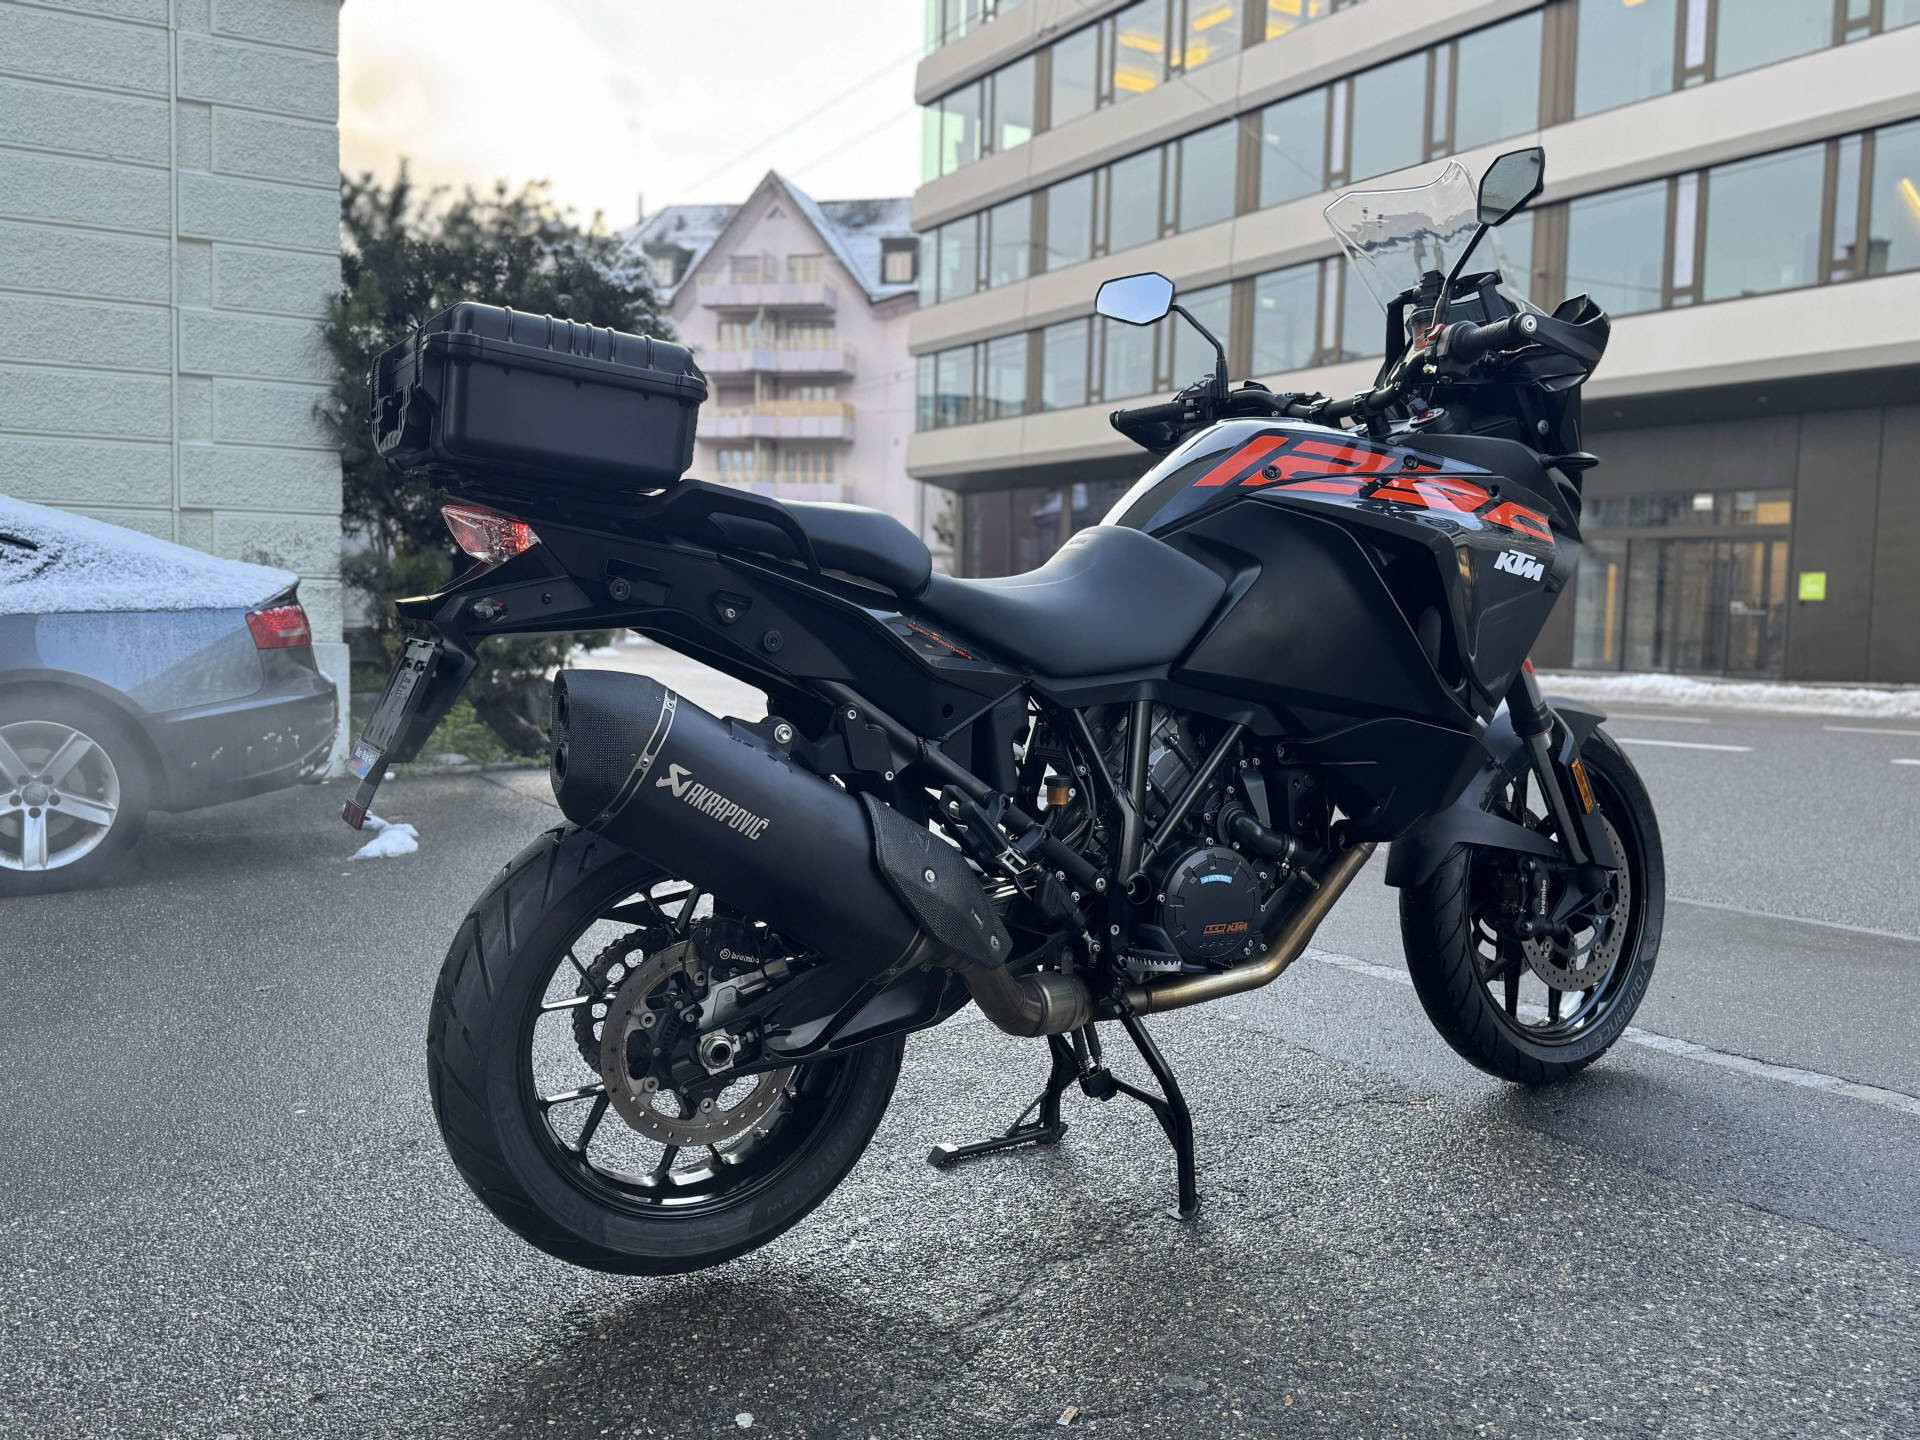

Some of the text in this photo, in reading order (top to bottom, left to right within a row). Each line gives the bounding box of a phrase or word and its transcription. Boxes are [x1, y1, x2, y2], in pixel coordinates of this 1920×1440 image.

[1493, 549, 1545, 582] KTM
[1539, 879, 1547, 915] brembo
[731, 951, 760, 964] brembo
[1594, 964, 1649, 1046] TOURANCE
